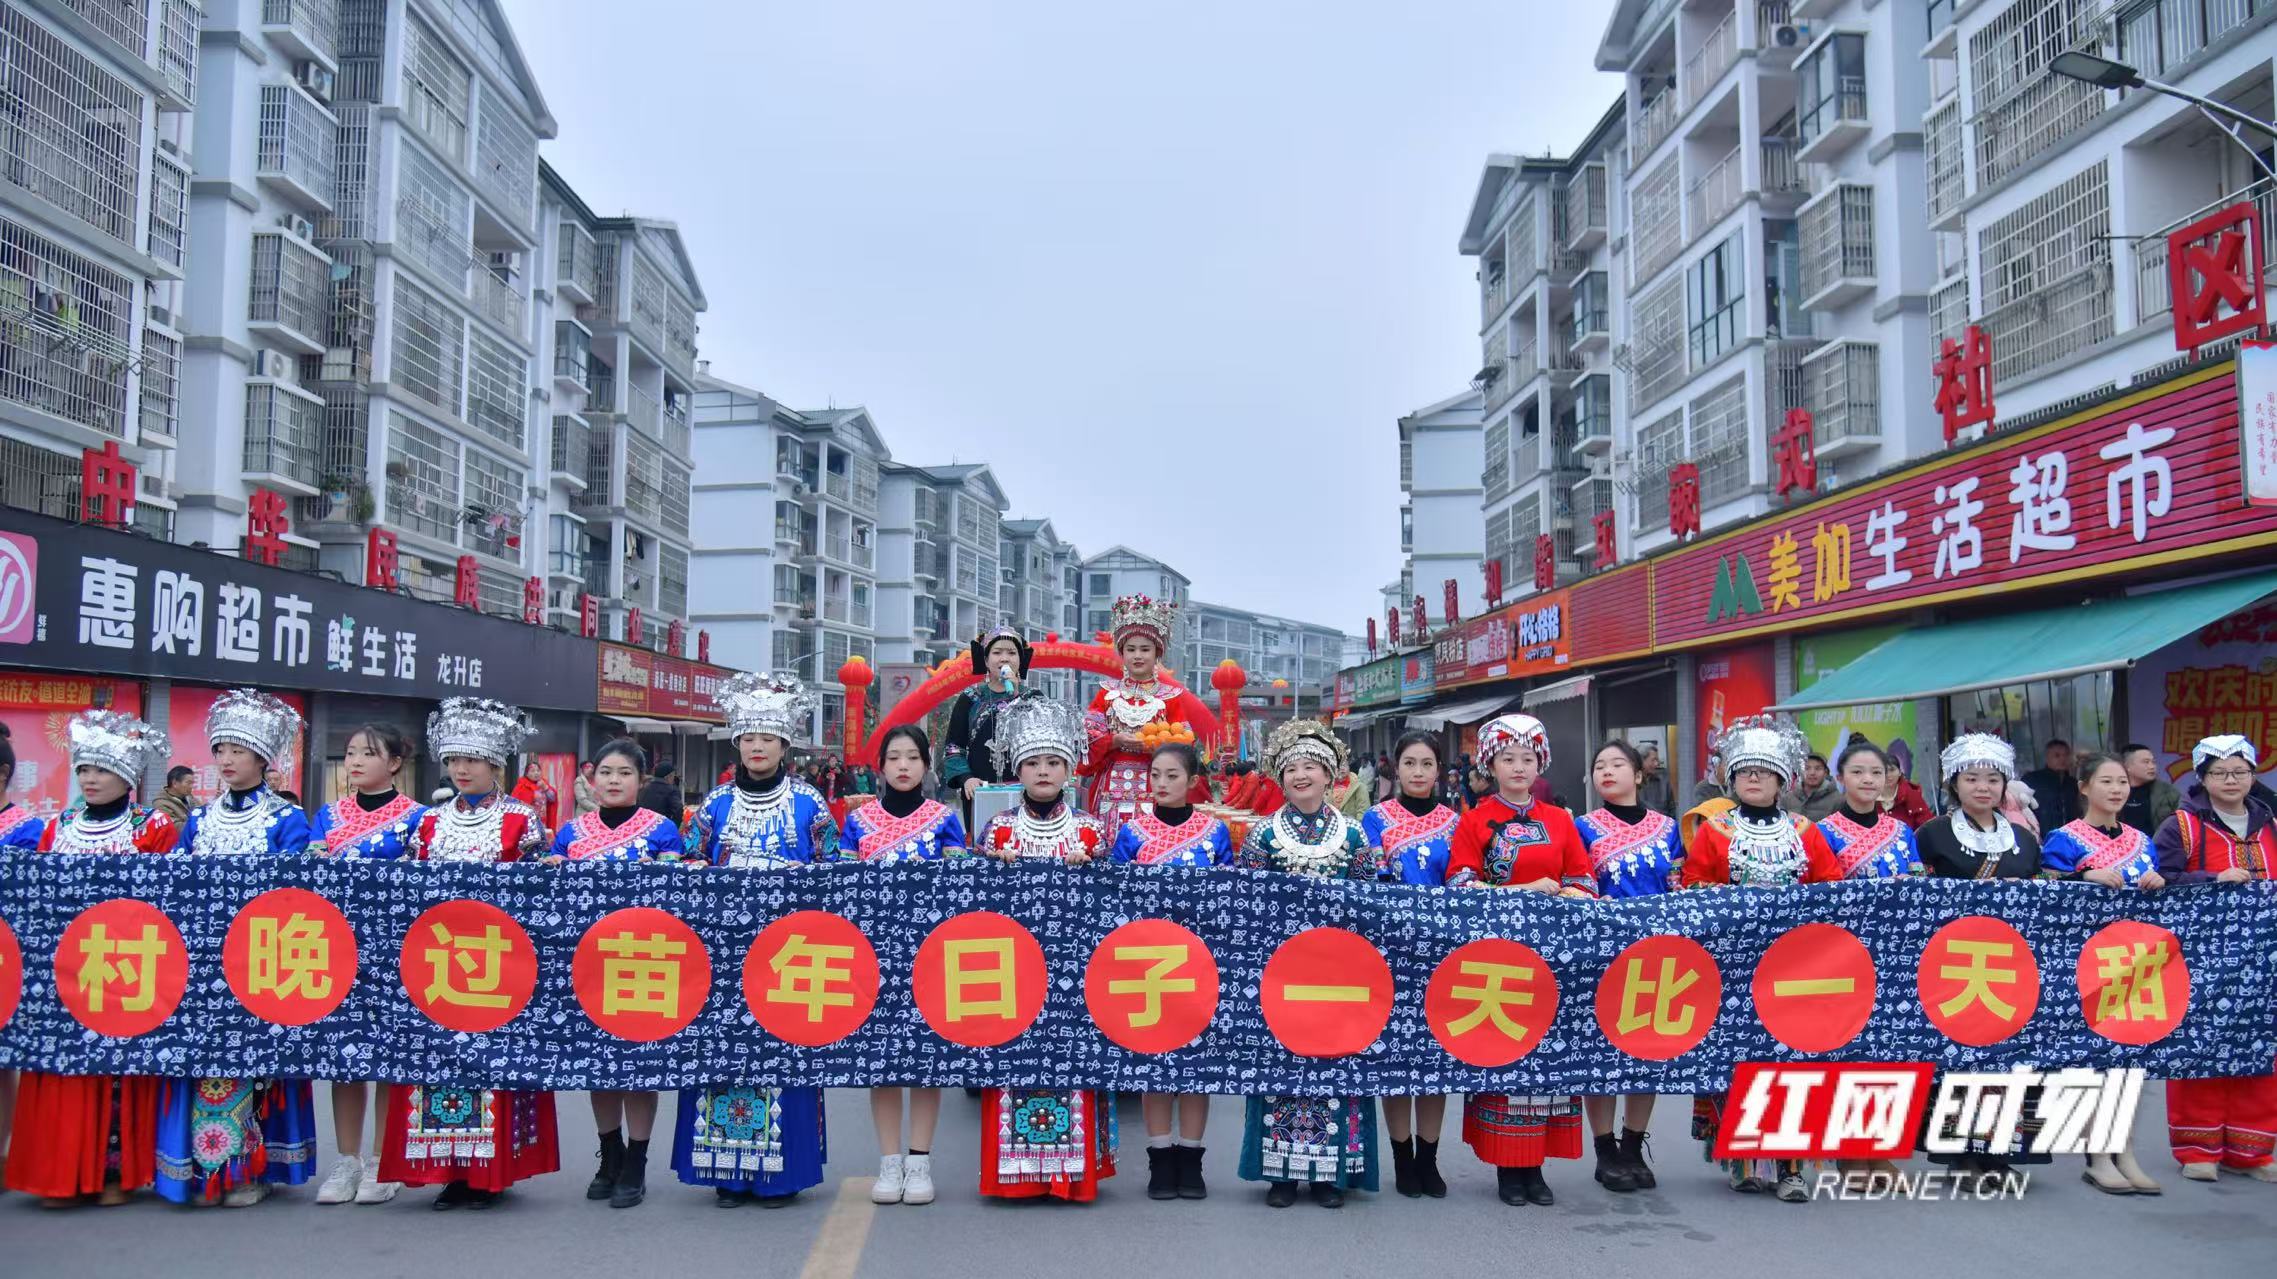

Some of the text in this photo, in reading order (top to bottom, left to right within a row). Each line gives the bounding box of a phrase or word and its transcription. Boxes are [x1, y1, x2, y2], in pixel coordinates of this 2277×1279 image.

[1769, 423, 2176, 613] 美加生活超市
[79, 556, 313, 667] 惠购超市
[327, 616, 417, 681] 鲜生活
[437, 653, 483, 688] 龙升店
[0, 913, 2170, 1041] 村晚过苗年日子一天比一天甜
